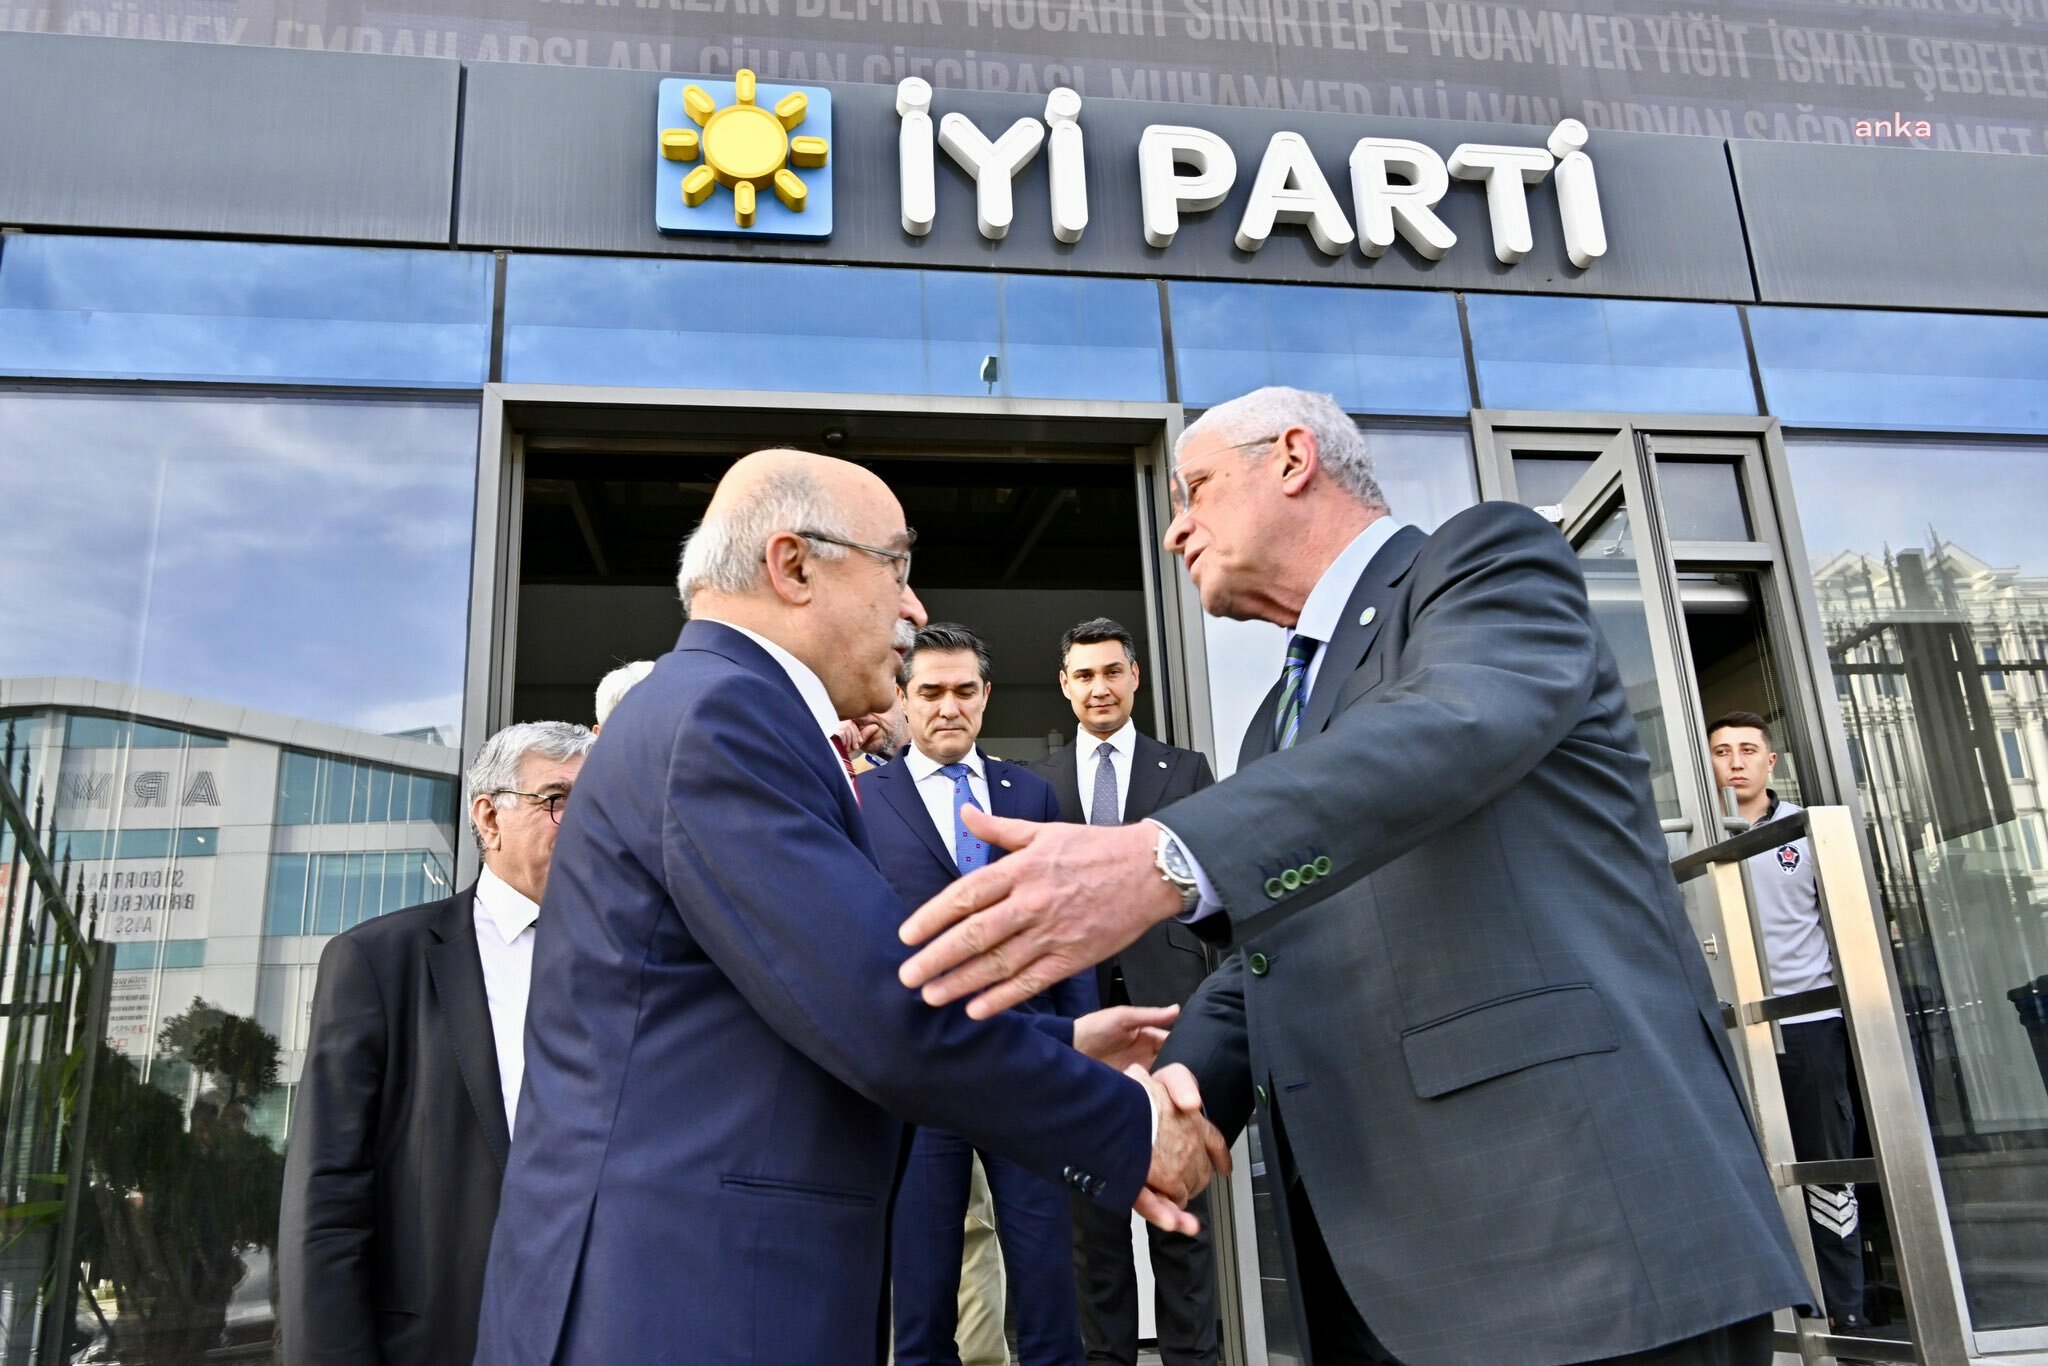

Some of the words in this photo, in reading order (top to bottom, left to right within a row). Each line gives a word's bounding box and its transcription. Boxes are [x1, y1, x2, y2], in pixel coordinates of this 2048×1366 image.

[1425, 2, 1642, 71] MUAMMER
[1645, 11, 1749, 79] YİĞİT
[1768, 19, 1906, 89] İSMAİL
[896, 77, 1089, 244] İYİ
[1139, 118, 1607, 268] PARTİ
